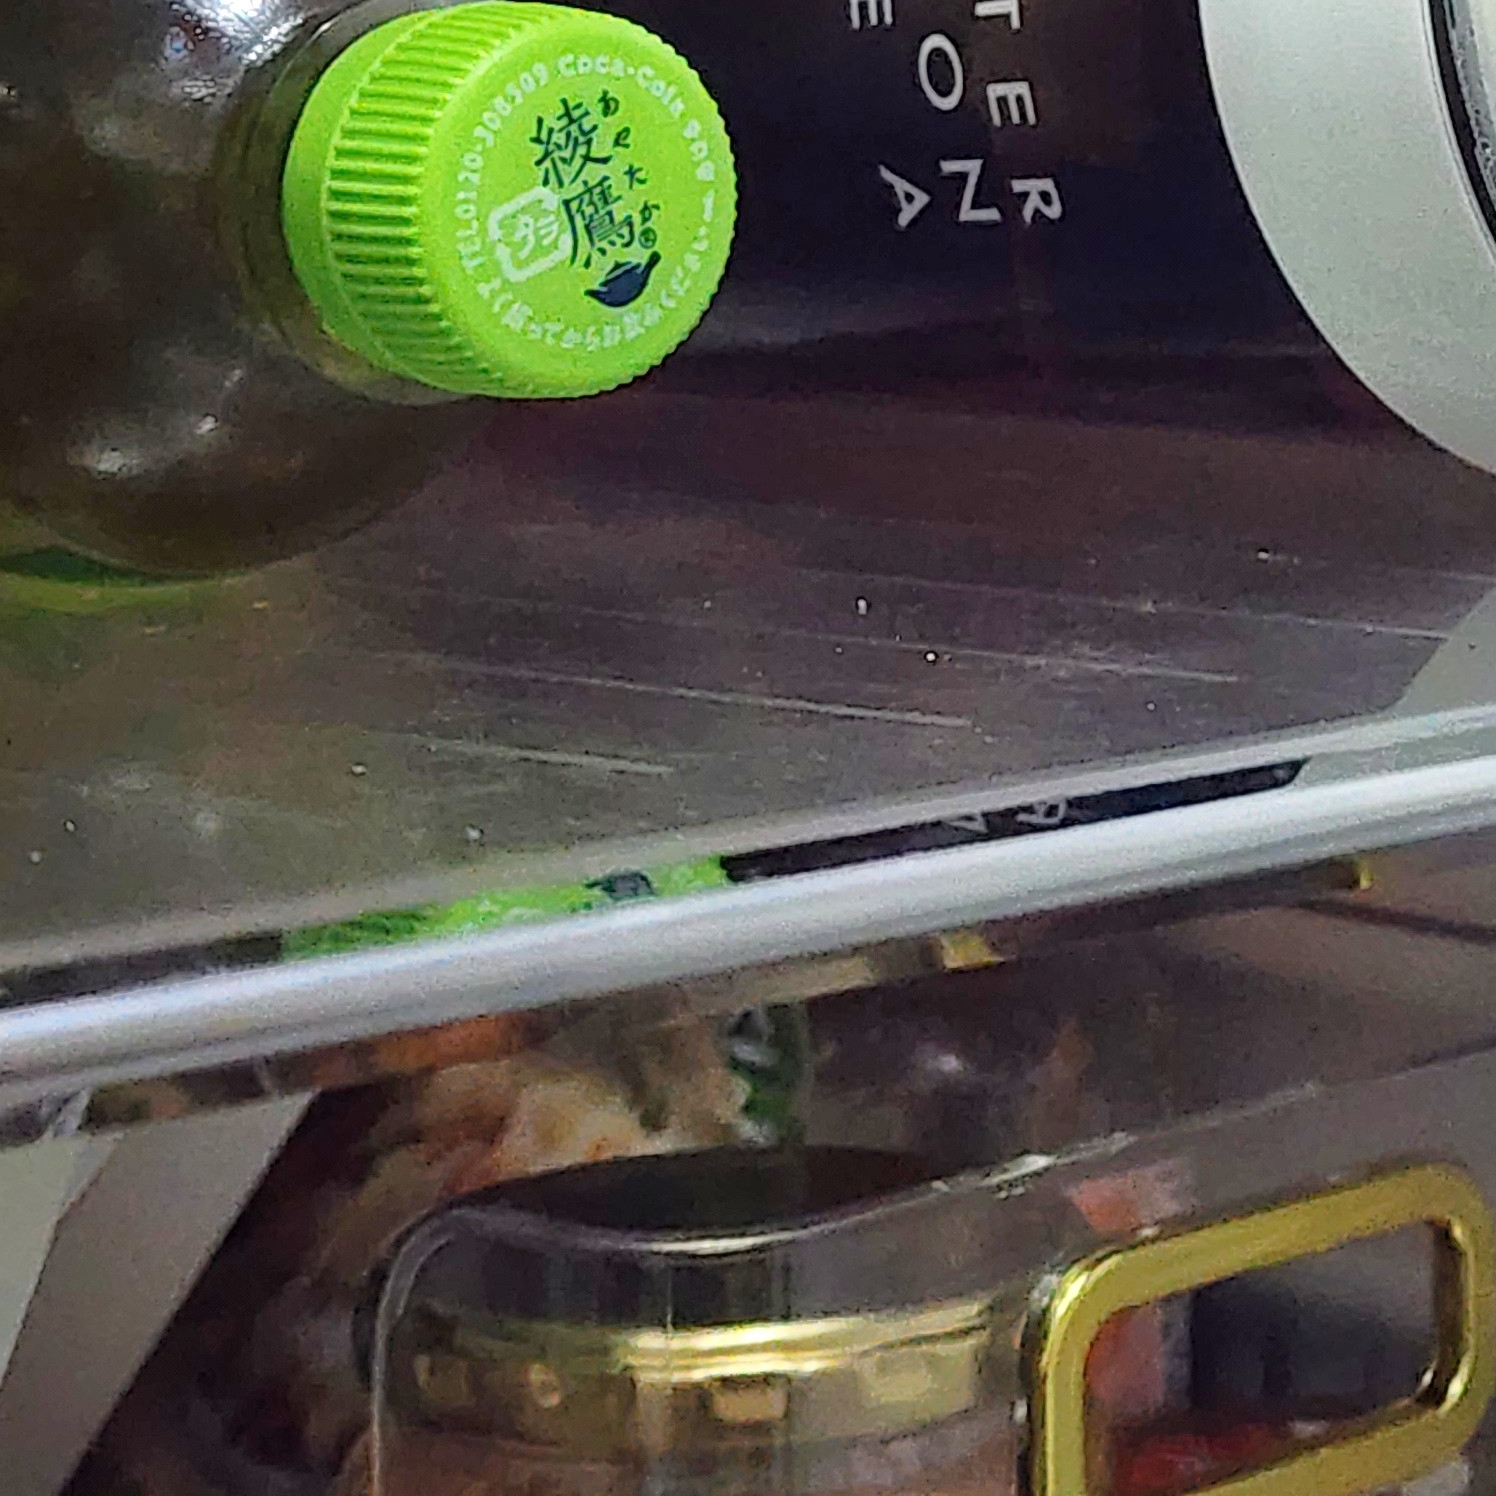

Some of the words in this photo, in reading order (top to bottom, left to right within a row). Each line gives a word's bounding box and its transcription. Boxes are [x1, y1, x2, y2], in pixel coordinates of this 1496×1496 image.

[528, 96, 636, 270] 綾鷹
[597, 89, 660, 227] あやたか
